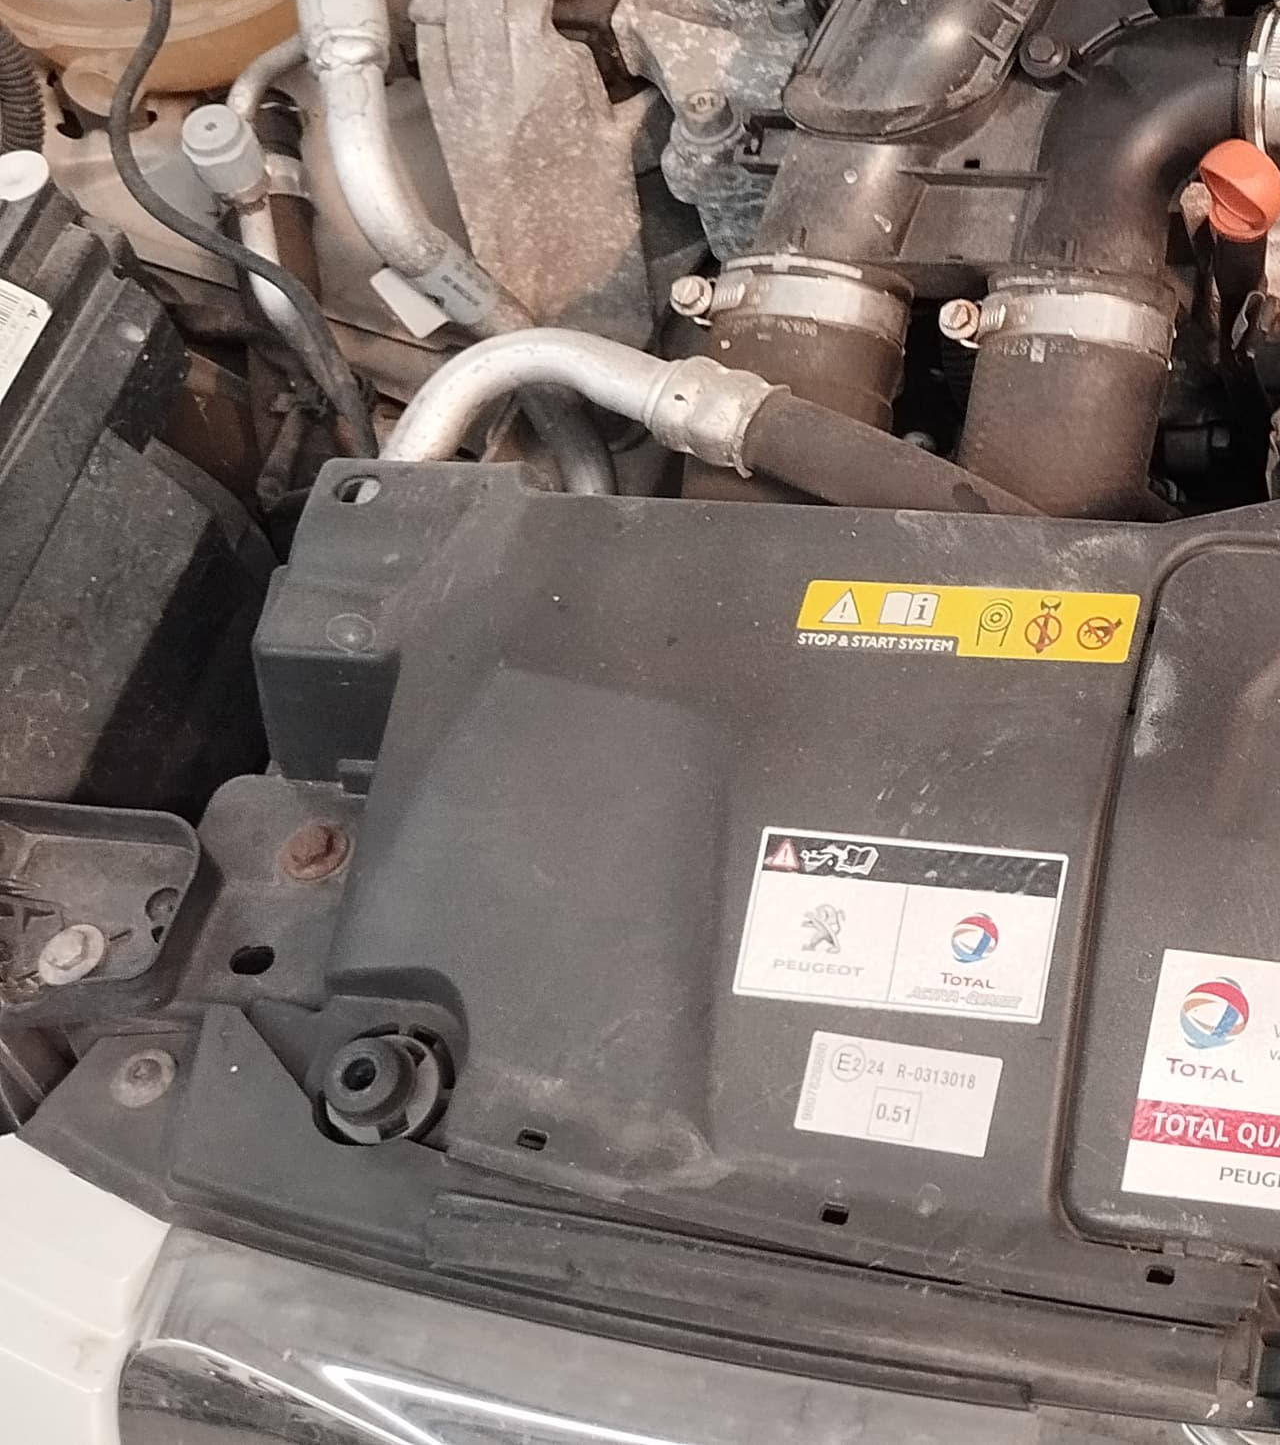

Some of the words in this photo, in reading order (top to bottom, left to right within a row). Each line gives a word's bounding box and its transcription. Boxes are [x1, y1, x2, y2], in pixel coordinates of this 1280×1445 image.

[797, 631, 837, 647] STOP
[837, 634, 849, 648] &
[850, 634, 898, 650] START
[898, 637, 954, 652] SYSTEM
[773, 957, 865, 978] PEUGEOT
[896, 1062, 977, 1090] R-0313018
[1166, 1057, 1245, 1083] TOTAL
[875, 1103, 912, 1125] 0.51
[1151, 1112, 1229, 1143] TOTAL
